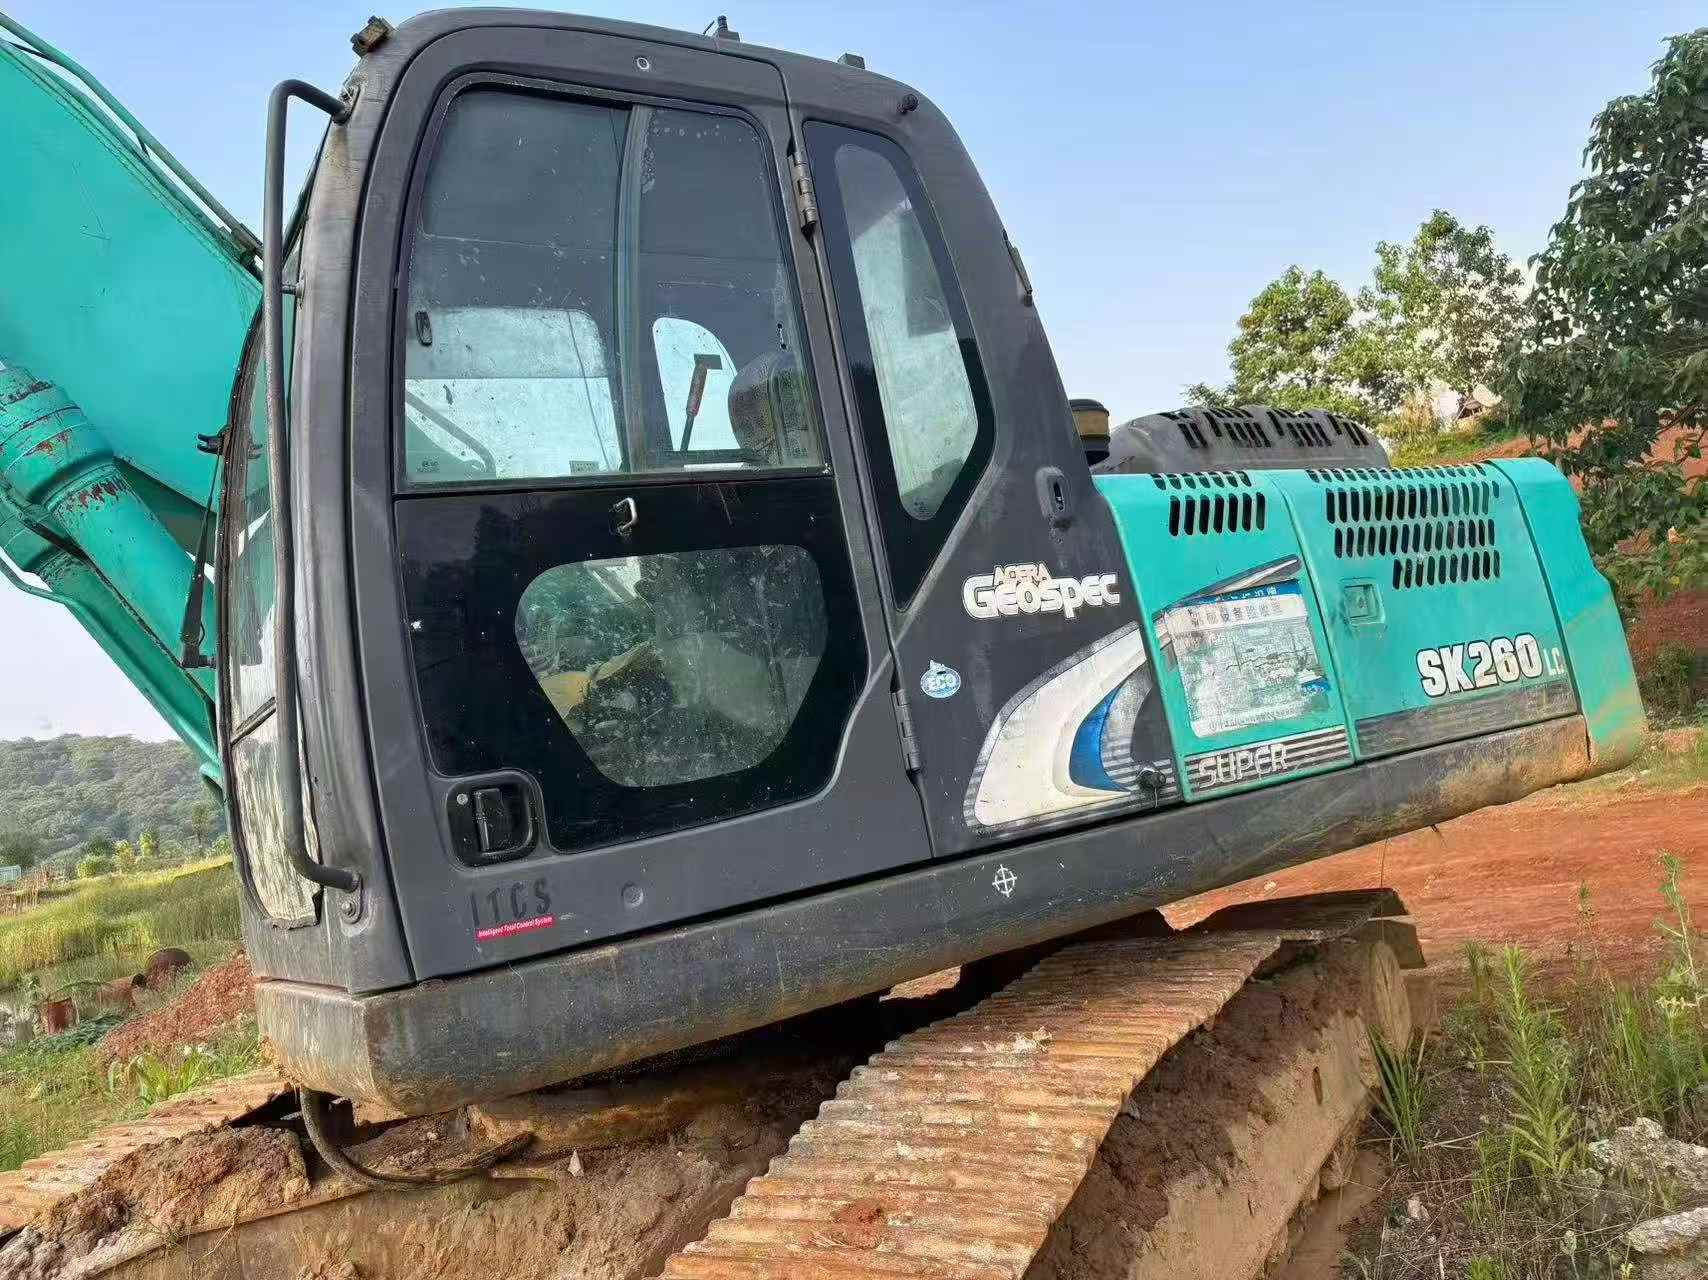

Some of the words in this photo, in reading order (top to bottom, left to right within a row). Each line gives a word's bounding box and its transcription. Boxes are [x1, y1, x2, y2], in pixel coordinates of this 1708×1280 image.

[1416, 632, 1543, 698] SK260
[1198, 743, 1288, 788] SUPER
[471, 878, 551, 926] ITCS
